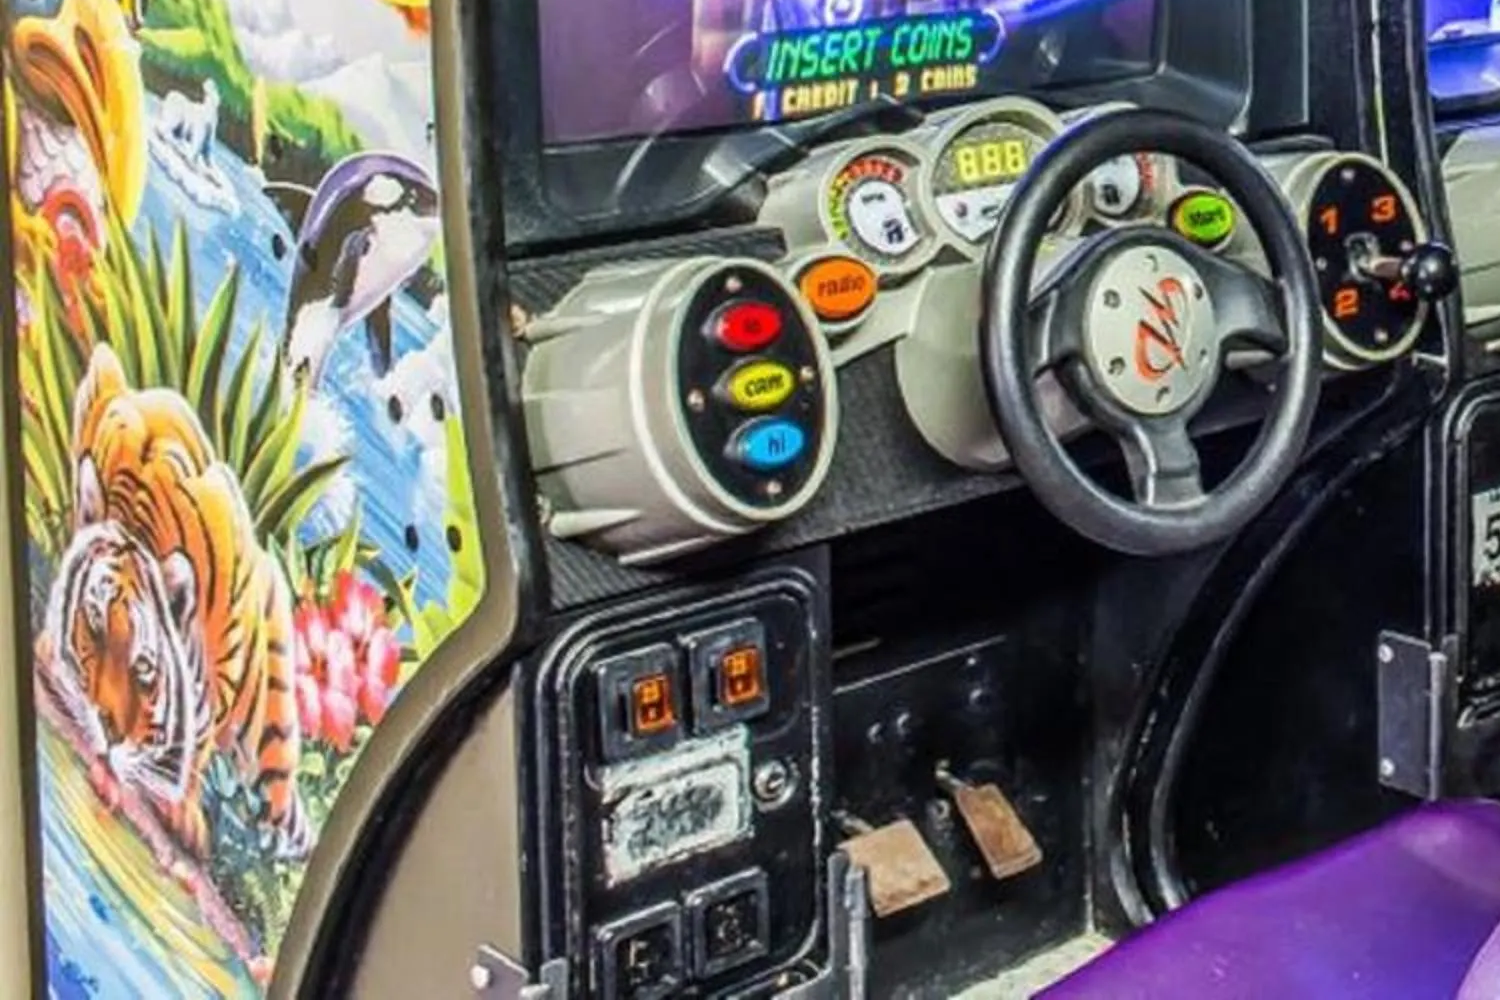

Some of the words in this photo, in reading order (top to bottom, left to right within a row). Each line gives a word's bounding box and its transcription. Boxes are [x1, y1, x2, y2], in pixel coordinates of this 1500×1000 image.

[766, 27, 881, 82] INSERT
[890, 18, 974, 66] COINS
[1319, 206, 1338, 235] 1
[1372, 194, 1397, 224] 3
[1334, 288, 1360, 318] 2
